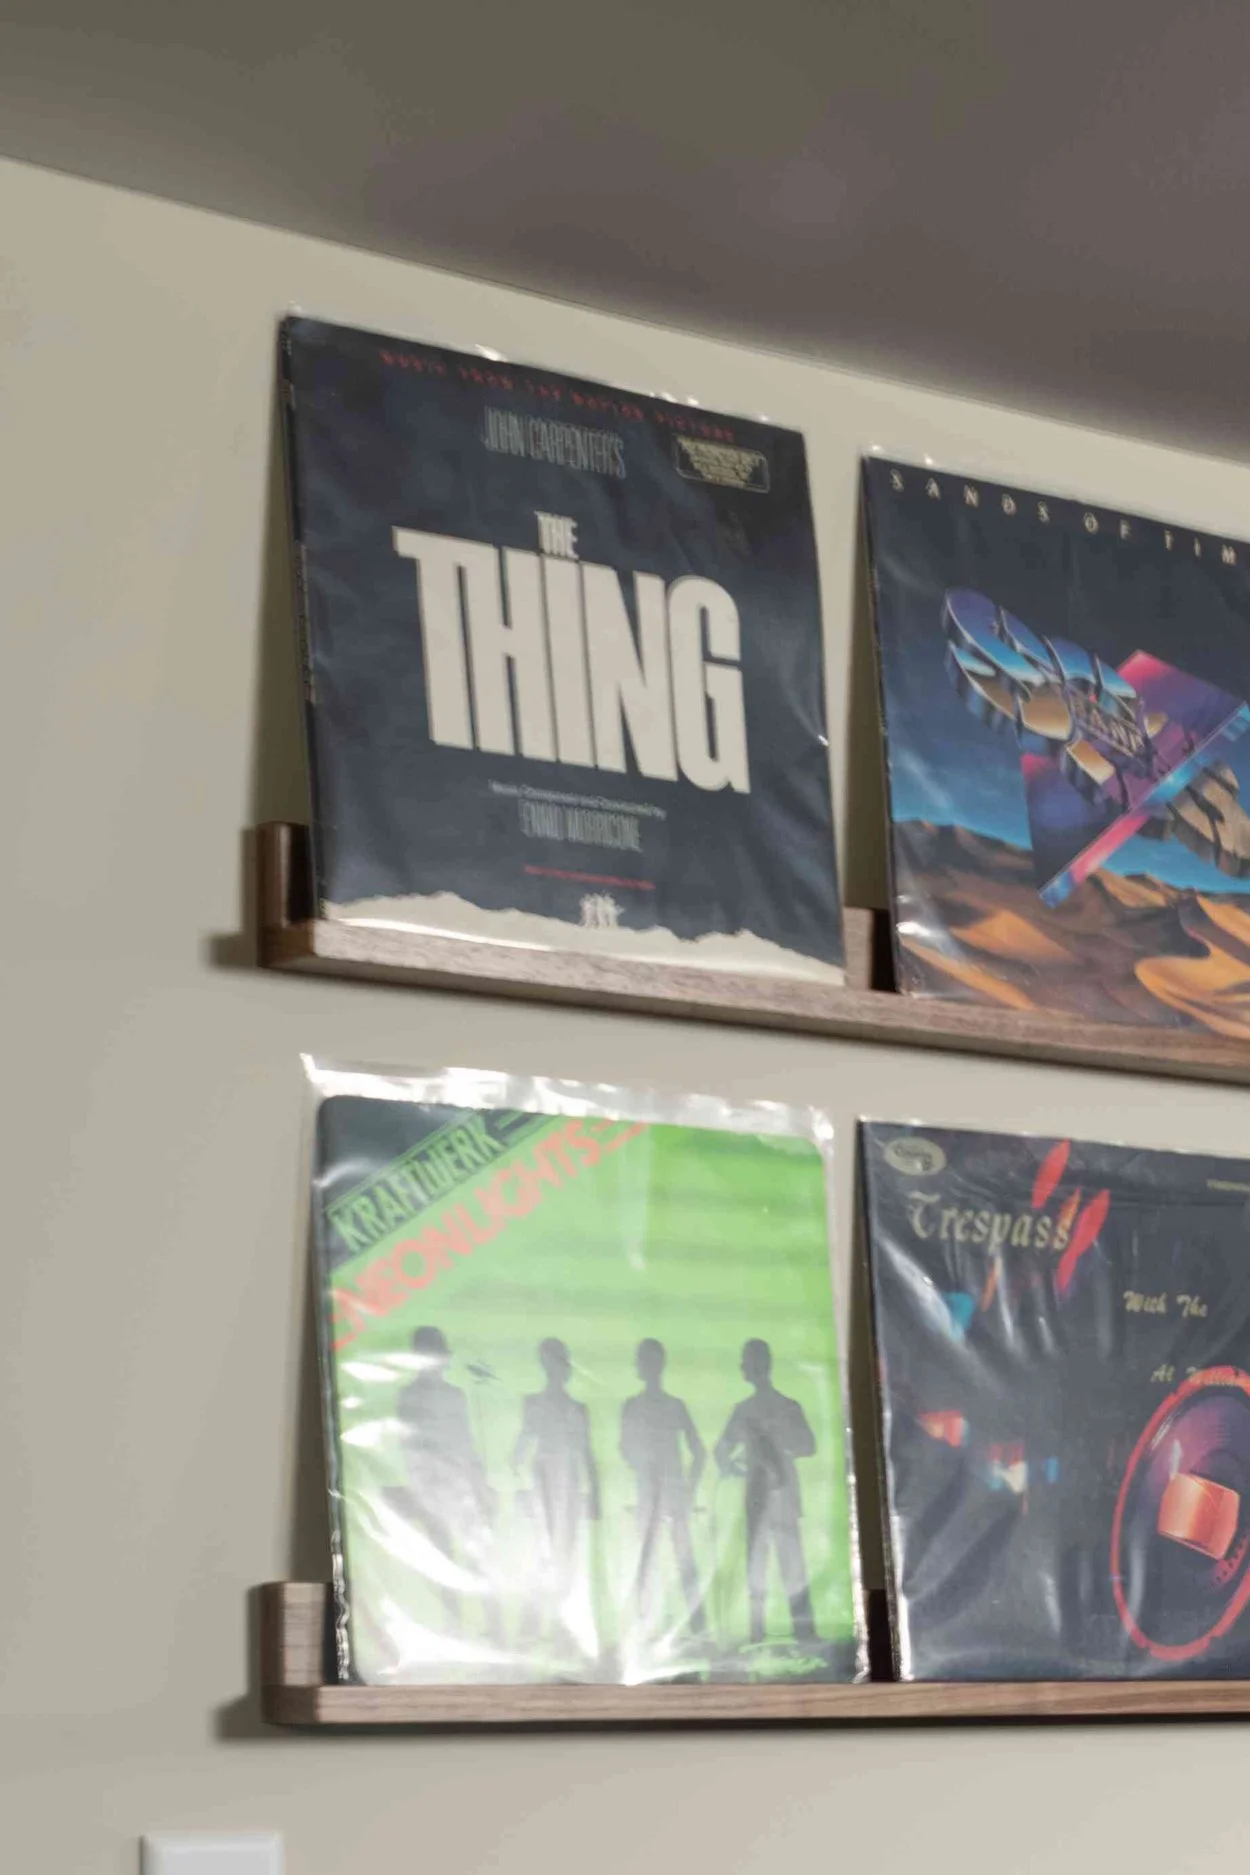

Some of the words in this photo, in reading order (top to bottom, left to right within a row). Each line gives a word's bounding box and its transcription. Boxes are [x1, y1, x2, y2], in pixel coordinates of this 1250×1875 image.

[533, 510, 578, 560] THE
[890, 468, 1050, 524] SANDS
[1083, 511, 1131, 540] OF
[392, 525, 750, 794] THING
[328, 1111, 506, 1251] KRAFTWERK
[907, 1190, 1070, 1256] Trespass
